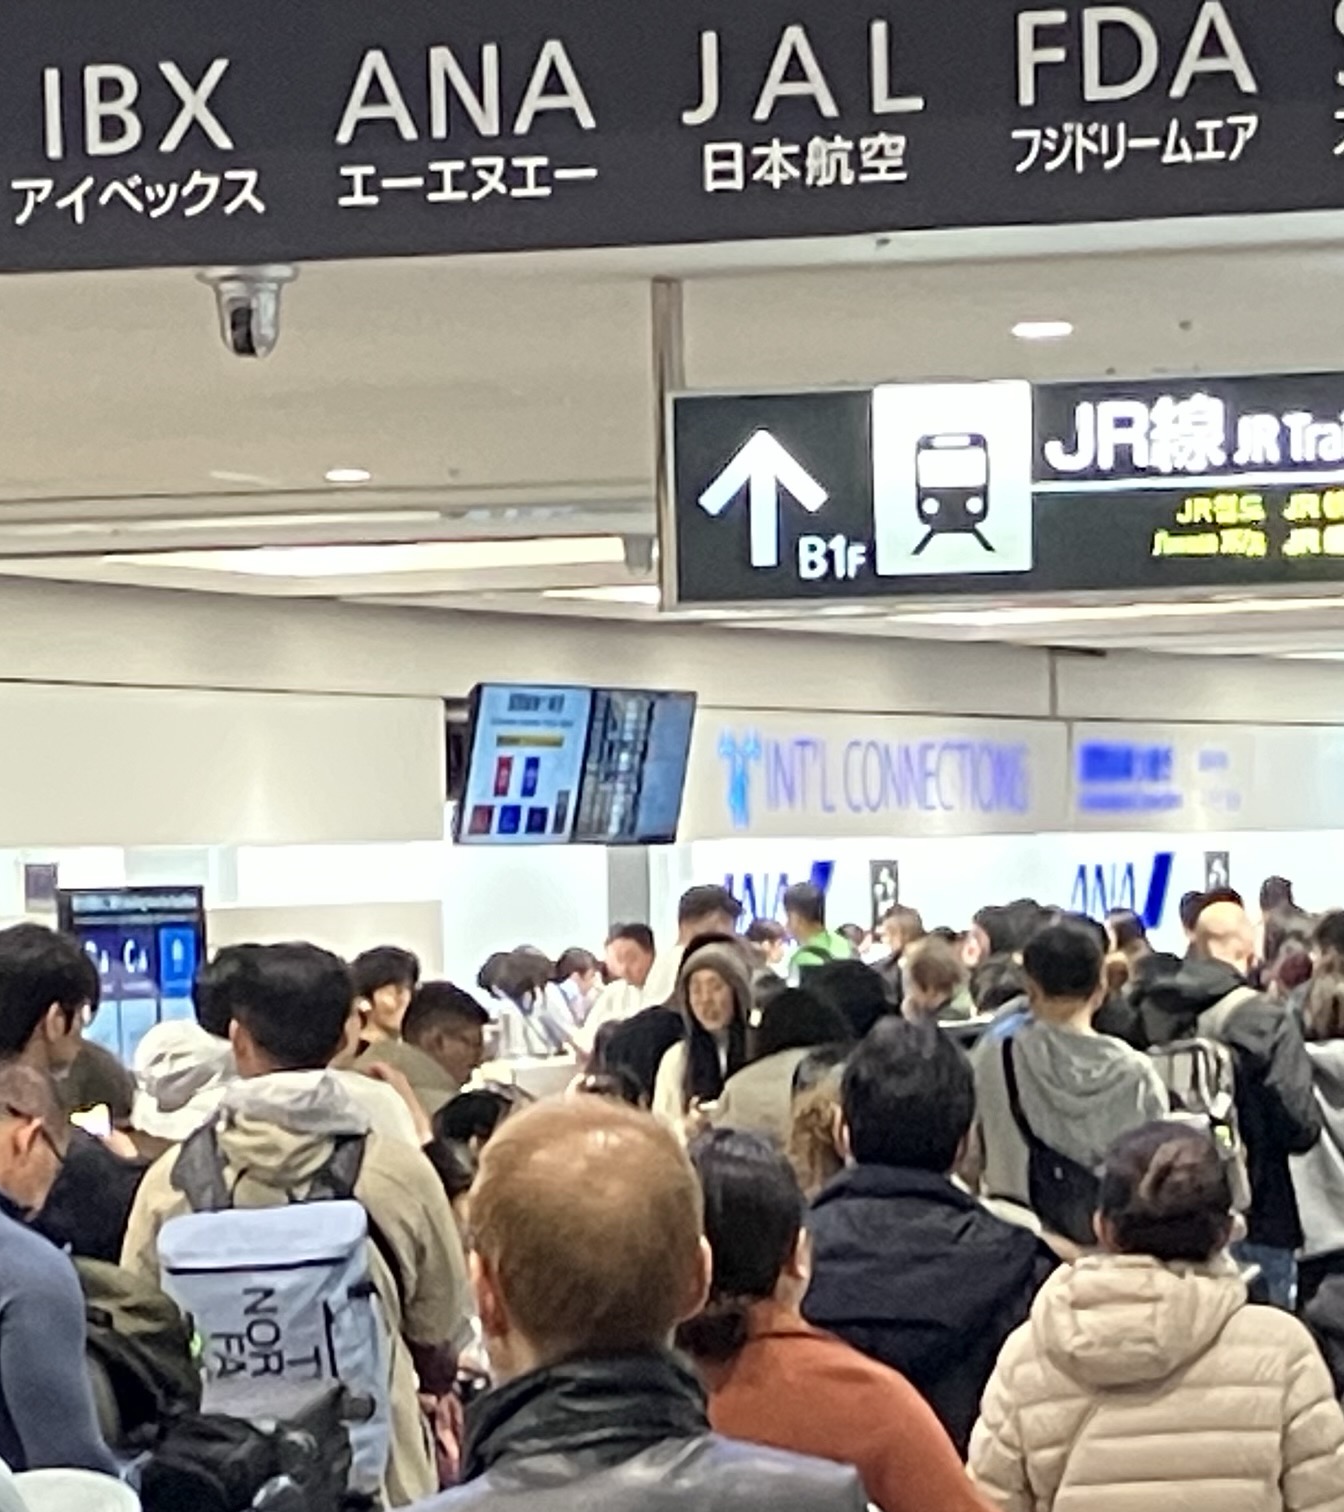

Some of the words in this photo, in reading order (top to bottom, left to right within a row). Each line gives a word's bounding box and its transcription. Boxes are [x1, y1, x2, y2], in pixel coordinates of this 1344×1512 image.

[682, 19, 924, 125] JAL
[1018, 0, 1257, 106] FDA
[44, 58, 234, 160] IBX
[335, 39, 596, 144] ANA
[338, 156, 599, 207] エーエヌエー
[704, 131, 908, 192] 日本航空
[1011, 114, 1259, 174] フジドリームエア
[11, 168, 266, 226] アイベックス
[798, 534, 866, 579] B1F
[242, 1287, 285, 1378] NOR
